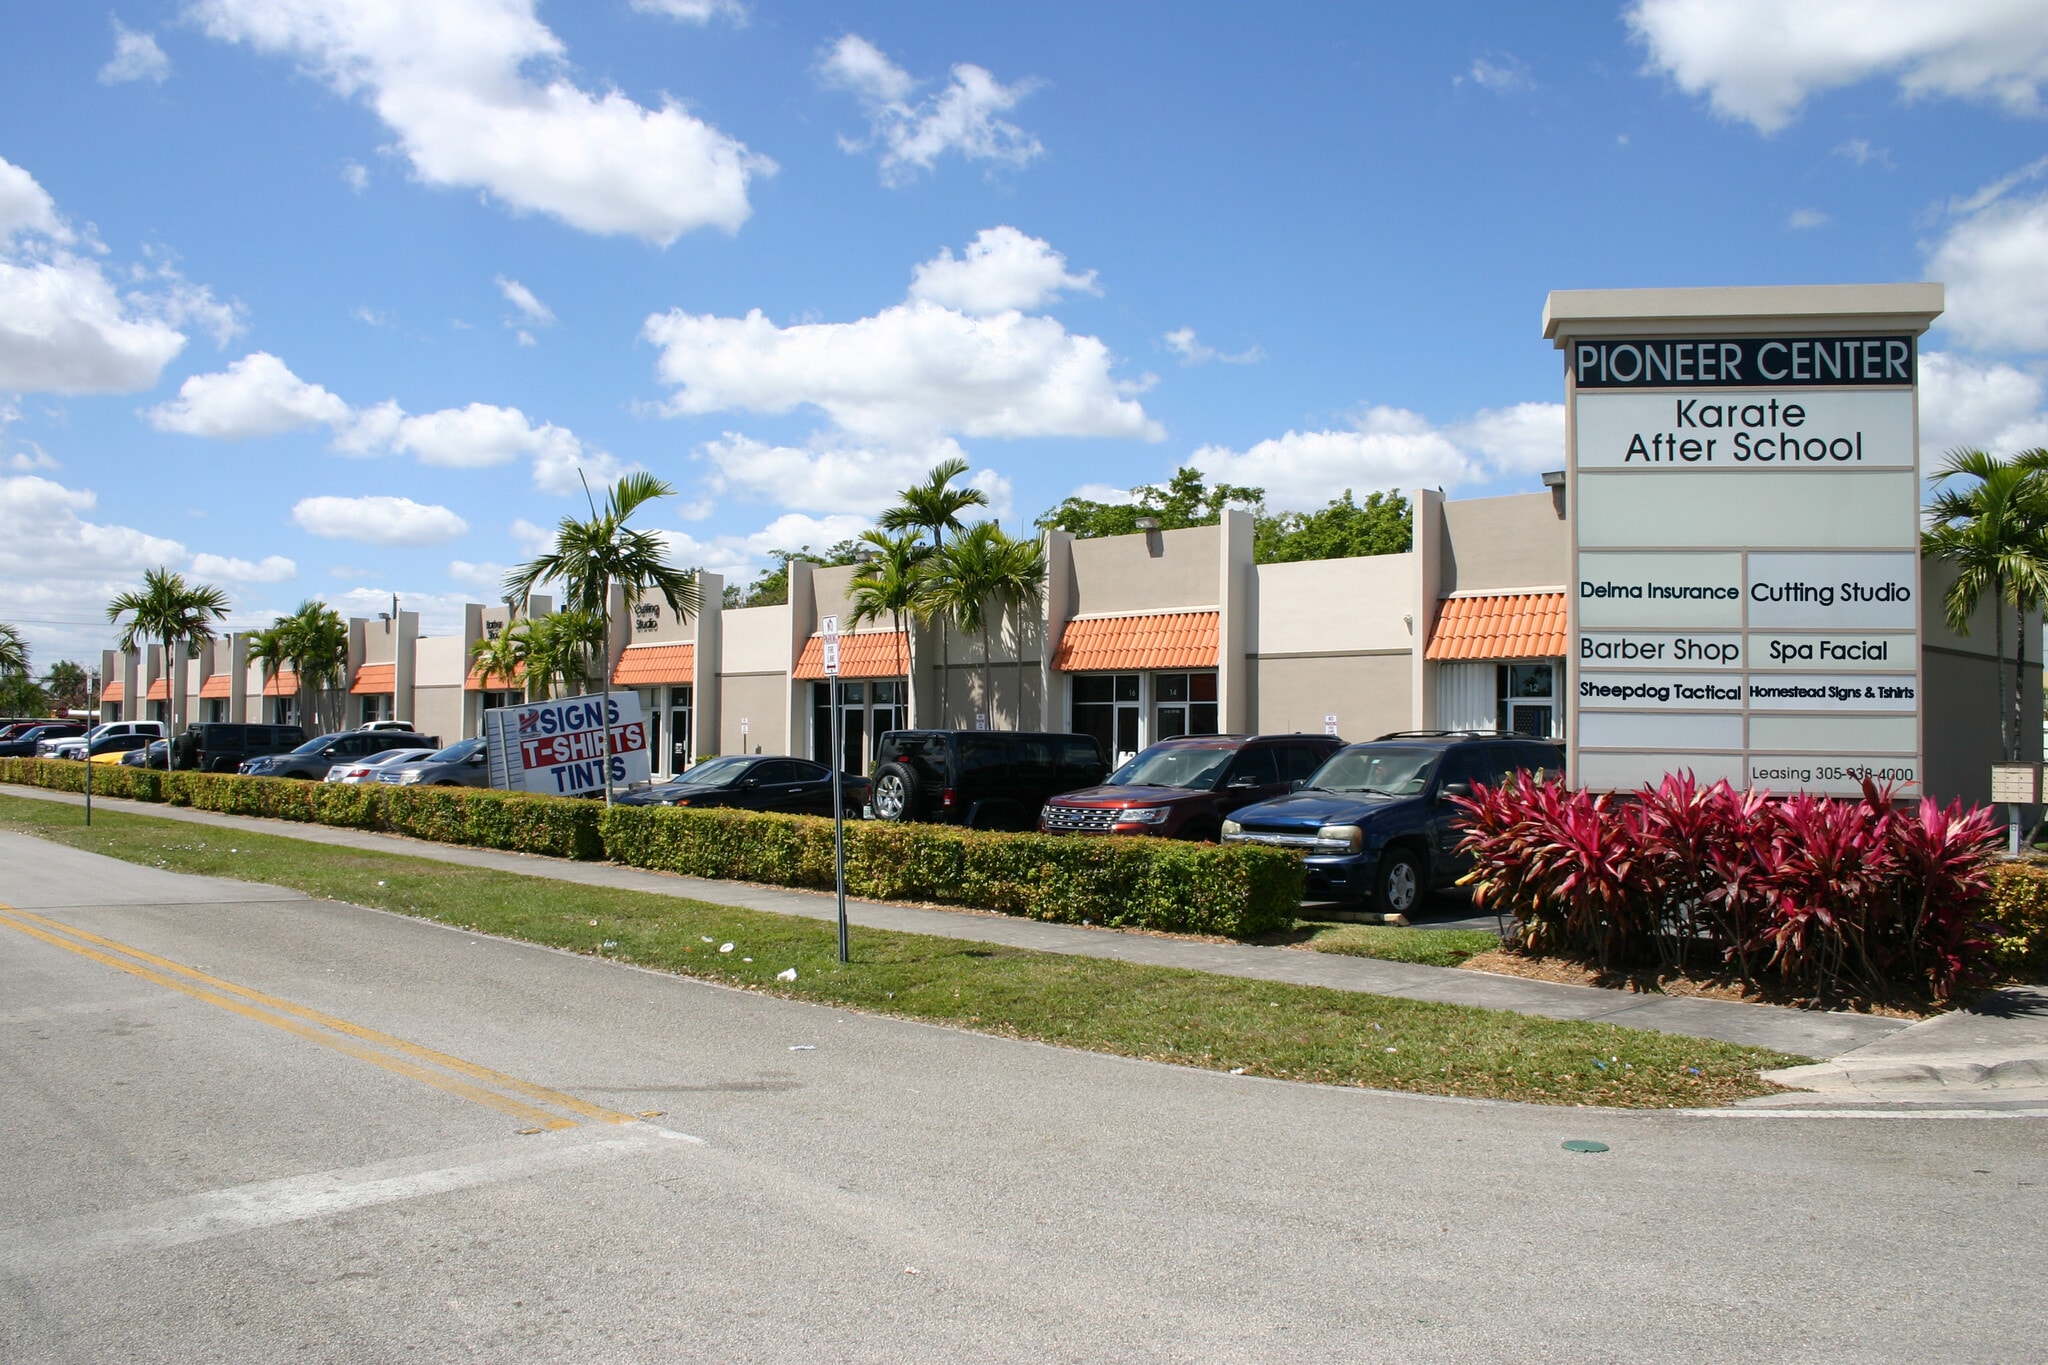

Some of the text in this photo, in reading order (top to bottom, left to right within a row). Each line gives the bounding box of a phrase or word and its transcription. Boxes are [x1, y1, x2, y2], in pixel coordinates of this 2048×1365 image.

[1578, 340, 1909, 382] PIONEER CENTER
[1676, 398, 1806, 428] Karate
[1624, 431, 1862, 462] After School
[1580, 582, 1740, 600] Delma Insurance
[1750, 582, 1911, 606] Cutting Studio
[636, 618, 658, 633] Studio
[1581, 638, 1739, 664] Barber Shop
[1769, 641, 1888, 664] Spa Facial
[1580, 682, 1742, 701] Sheepdog Tactical
[1749, 686, 1915, 701] Homestead Signs & Tshirts
[540, 699, 620, 735] SIGNS
[551, 757, 626, 793] TINTS
[1753, 767, 1914, 782] Leasing 305-938-4000
